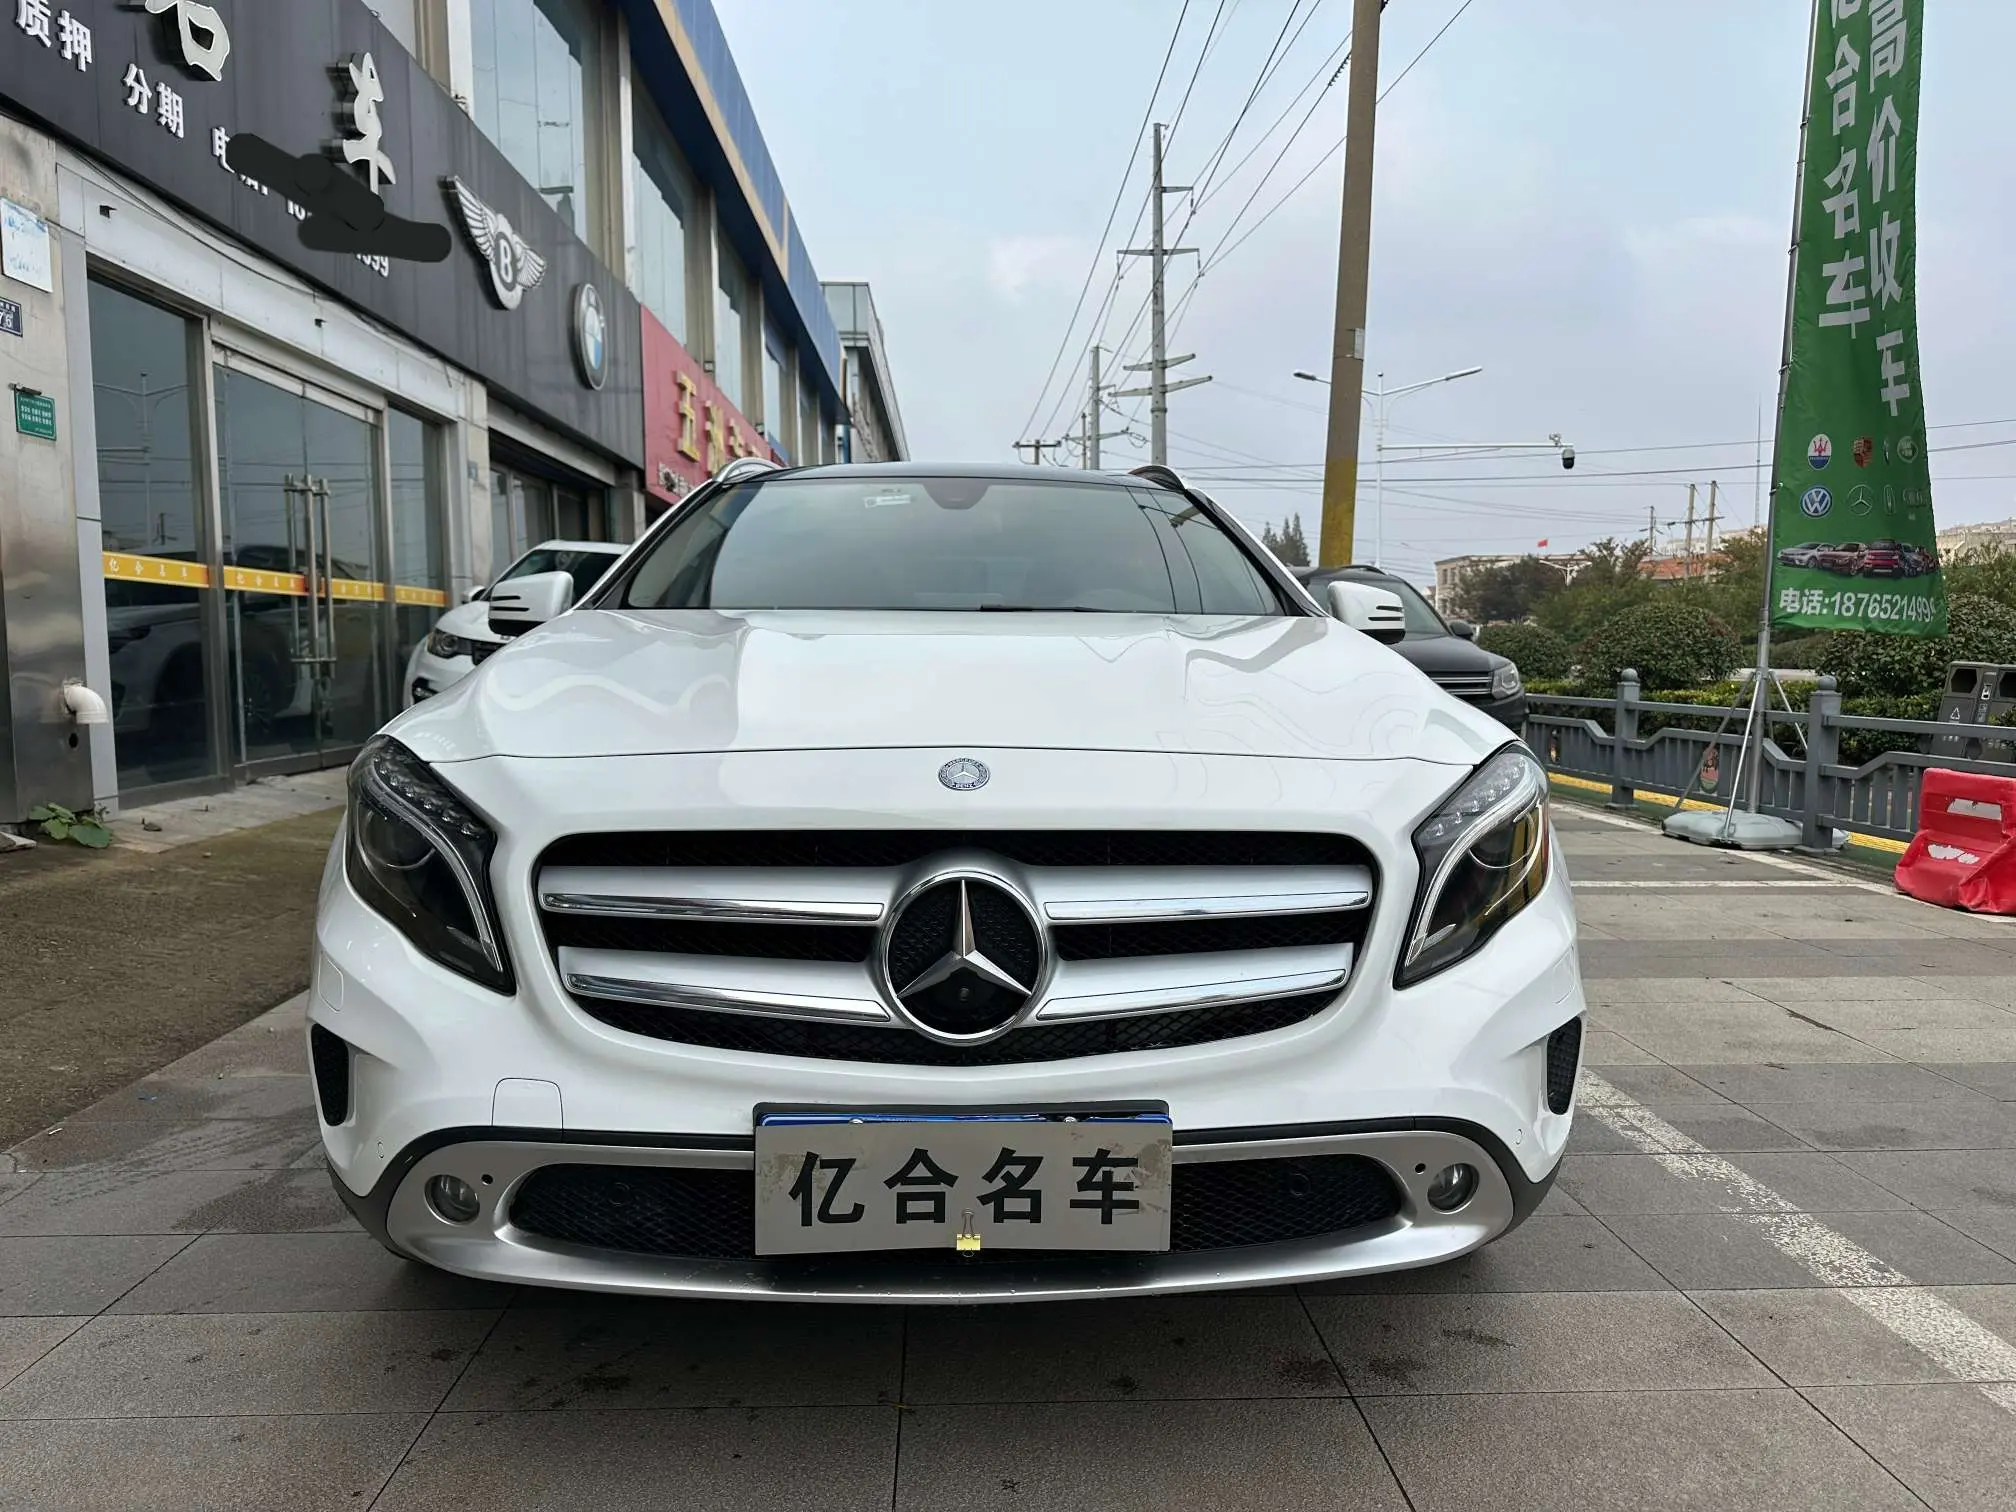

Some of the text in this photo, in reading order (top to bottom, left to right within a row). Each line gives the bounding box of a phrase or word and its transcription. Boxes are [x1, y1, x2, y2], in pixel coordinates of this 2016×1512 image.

[16, 0, 92, 72] 质押
[123, 63, 184, 139] 分期
[1867, 0, 1910, 416] 高价收车
[788, 1146, 1140, 1227] 亿合名车
